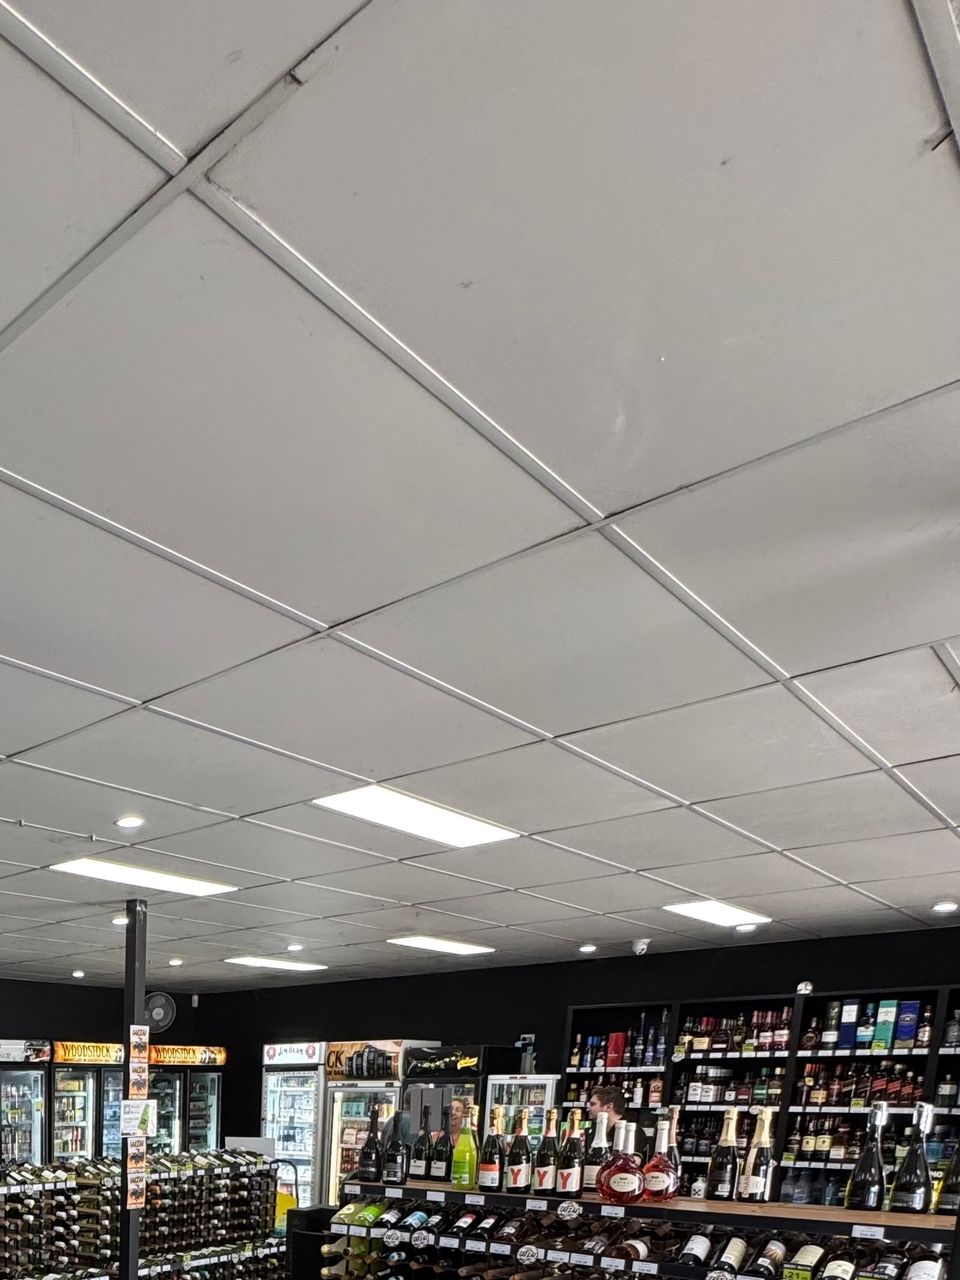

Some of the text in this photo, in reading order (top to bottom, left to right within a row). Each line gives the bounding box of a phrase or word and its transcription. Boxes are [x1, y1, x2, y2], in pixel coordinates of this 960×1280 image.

[62, 1044, 112, 1058] WOODSTOCK
[154, 1047, 197, 1059] WOODSTOCK
[510, 1167, 522, 1186] Y
[536, 1169, 548, 1188] Y
[559, 1171, 572, 1190] Y
